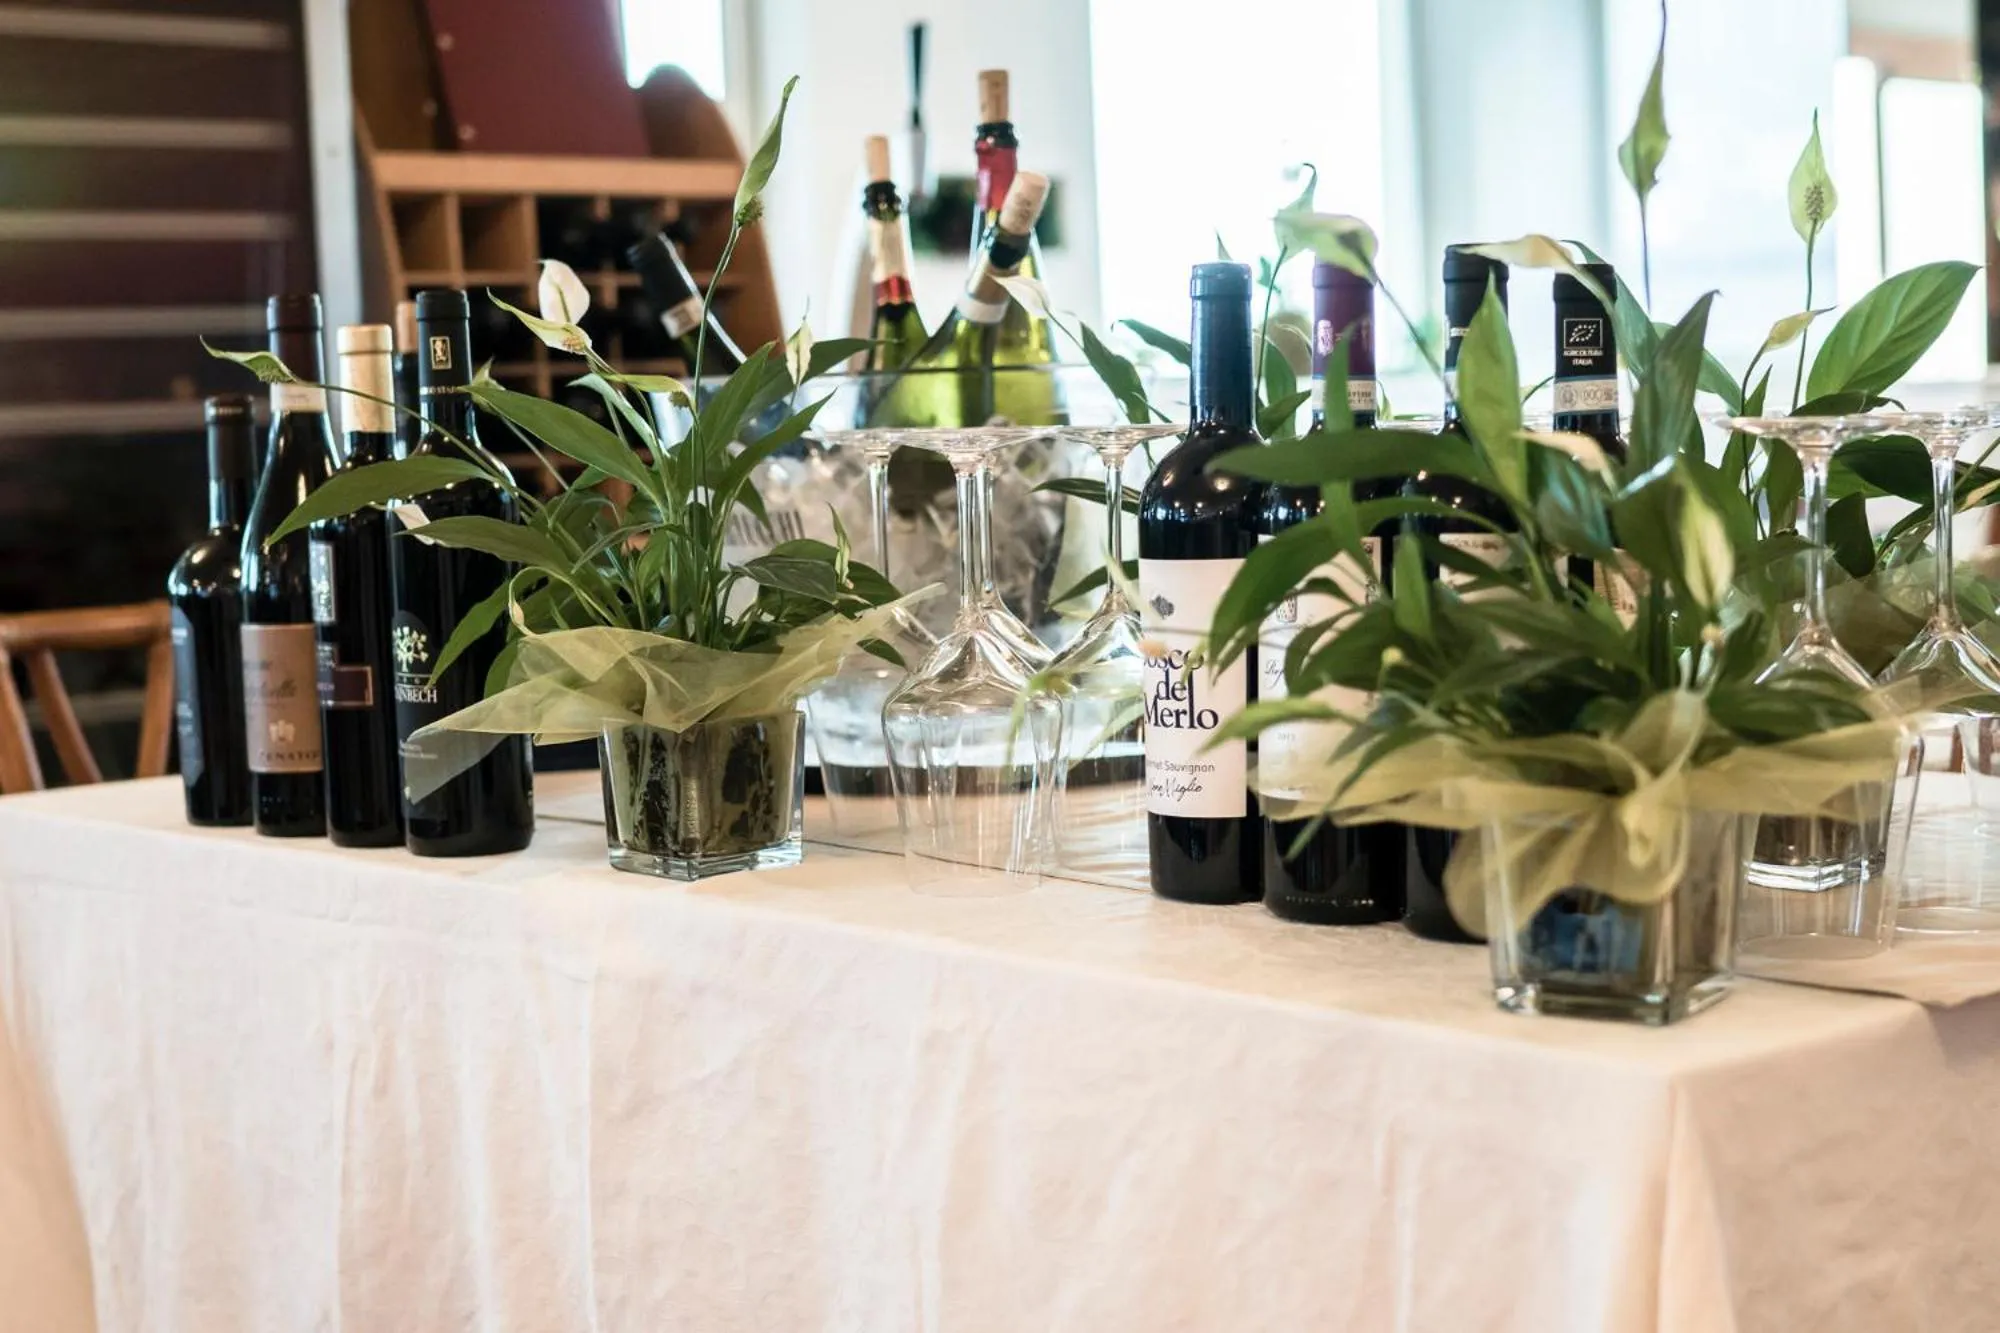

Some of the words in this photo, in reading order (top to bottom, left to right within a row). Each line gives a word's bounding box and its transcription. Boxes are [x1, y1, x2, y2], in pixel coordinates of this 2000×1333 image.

[1572, 358, 1593, 366] ITALIA
[1156, 668, 1194, 702] del
[1144, 668, 1219, 730] Merlo
[1164, 761, 1216, 775] Sauvignon
